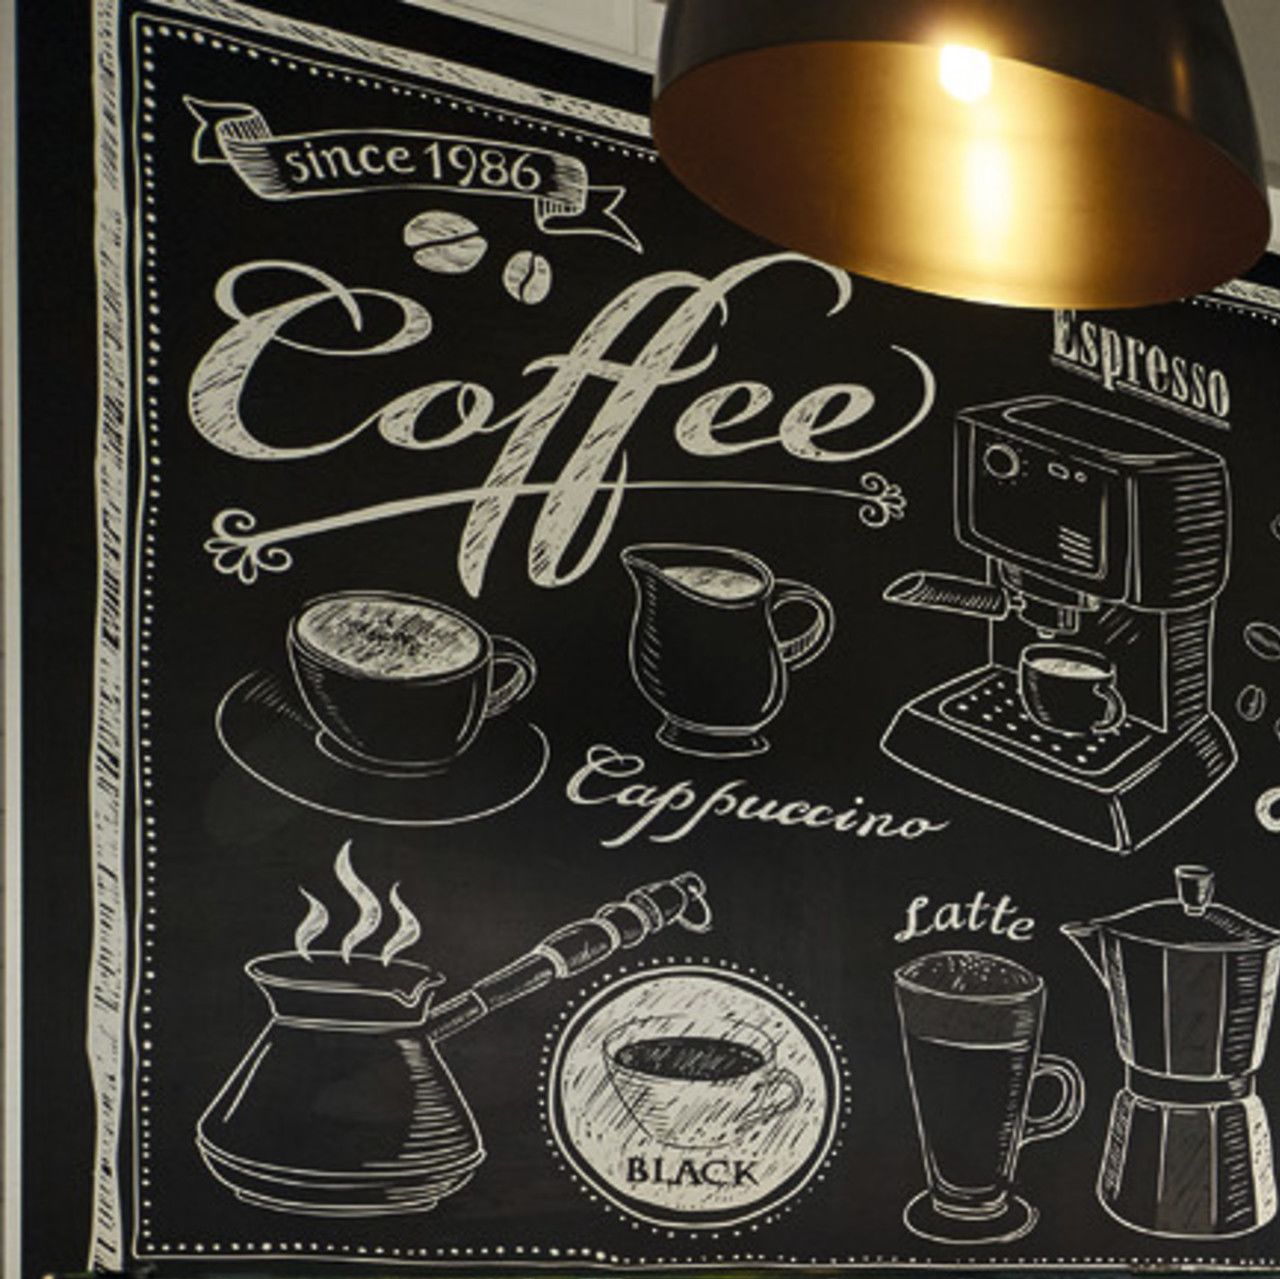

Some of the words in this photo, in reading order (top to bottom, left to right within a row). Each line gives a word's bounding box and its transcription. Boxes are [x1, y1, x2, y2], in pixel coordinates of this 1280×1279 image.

[284, 141, 414, 184] since
[424, 141, 542, 191] 1986
[1054, 309, 1230, 417] Espresso
[188, 251, 937, 599] Coffee
[566, 743, 951, 848] Cappuccino
[894, 891, 1037, 942] Latte
[625, 1156, 760, 1188] BLACK
